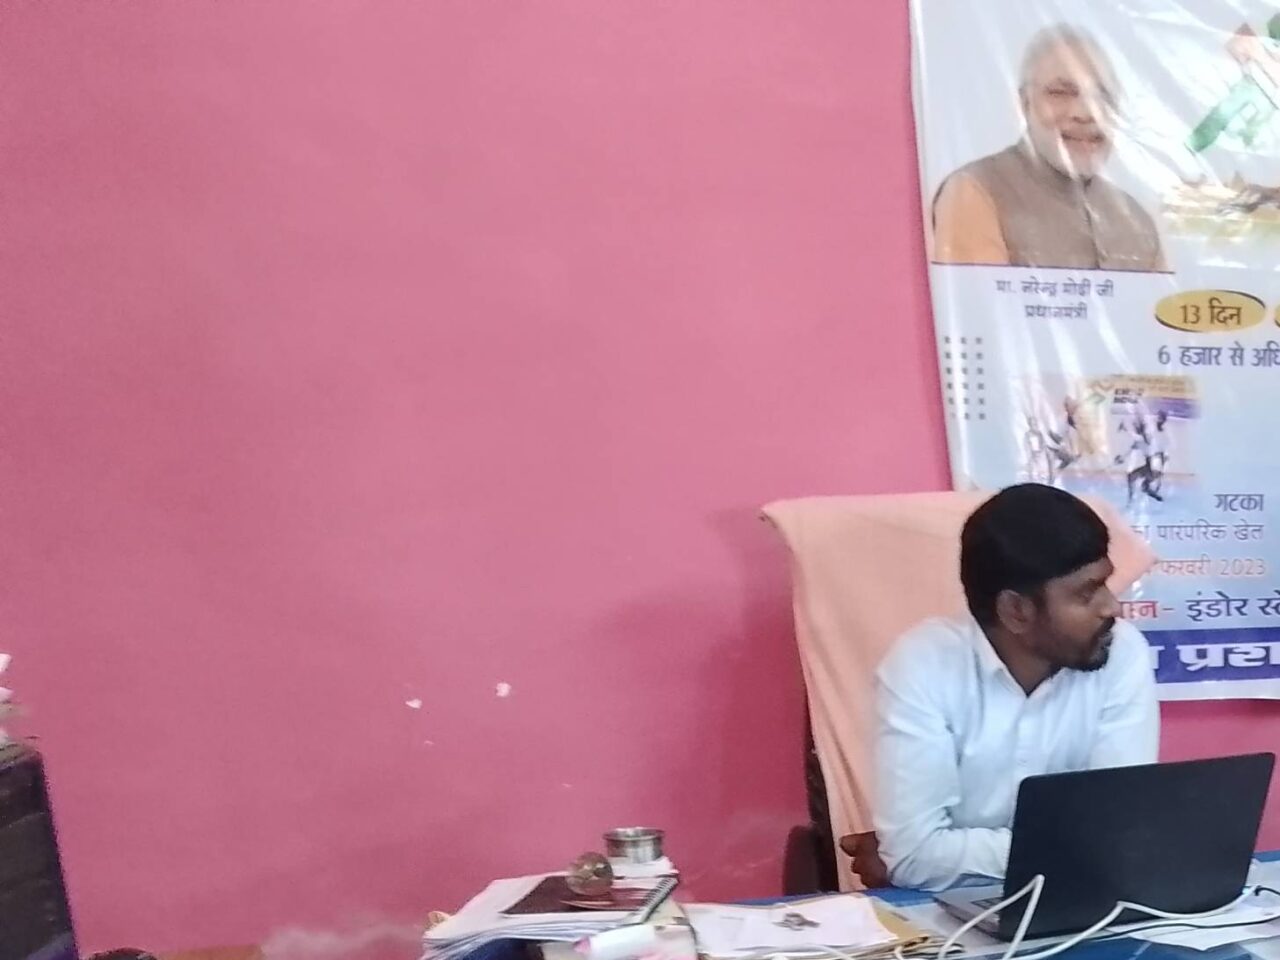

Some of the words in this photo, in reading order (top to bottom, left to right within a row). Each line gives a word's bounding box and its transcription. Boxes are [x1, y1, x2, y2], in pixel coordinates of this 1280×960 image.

[1180, 304, 1200, 323] 13
[1208, 297, 1242, 326] दिन
[1158, 345, 1171, 365] 6
[1179, 346, 1222, 366] हजार
[1228, 341, 1244, 366] से
[1214, 493, 1265, 512] गटका
[1157, 518, 1228, 541] पारंपरिक
[1234, 518, 1265, 541] खेल
[1219, 558, 1267, 576] 2023
[1185, 590, 1249, 622] इंडोर
